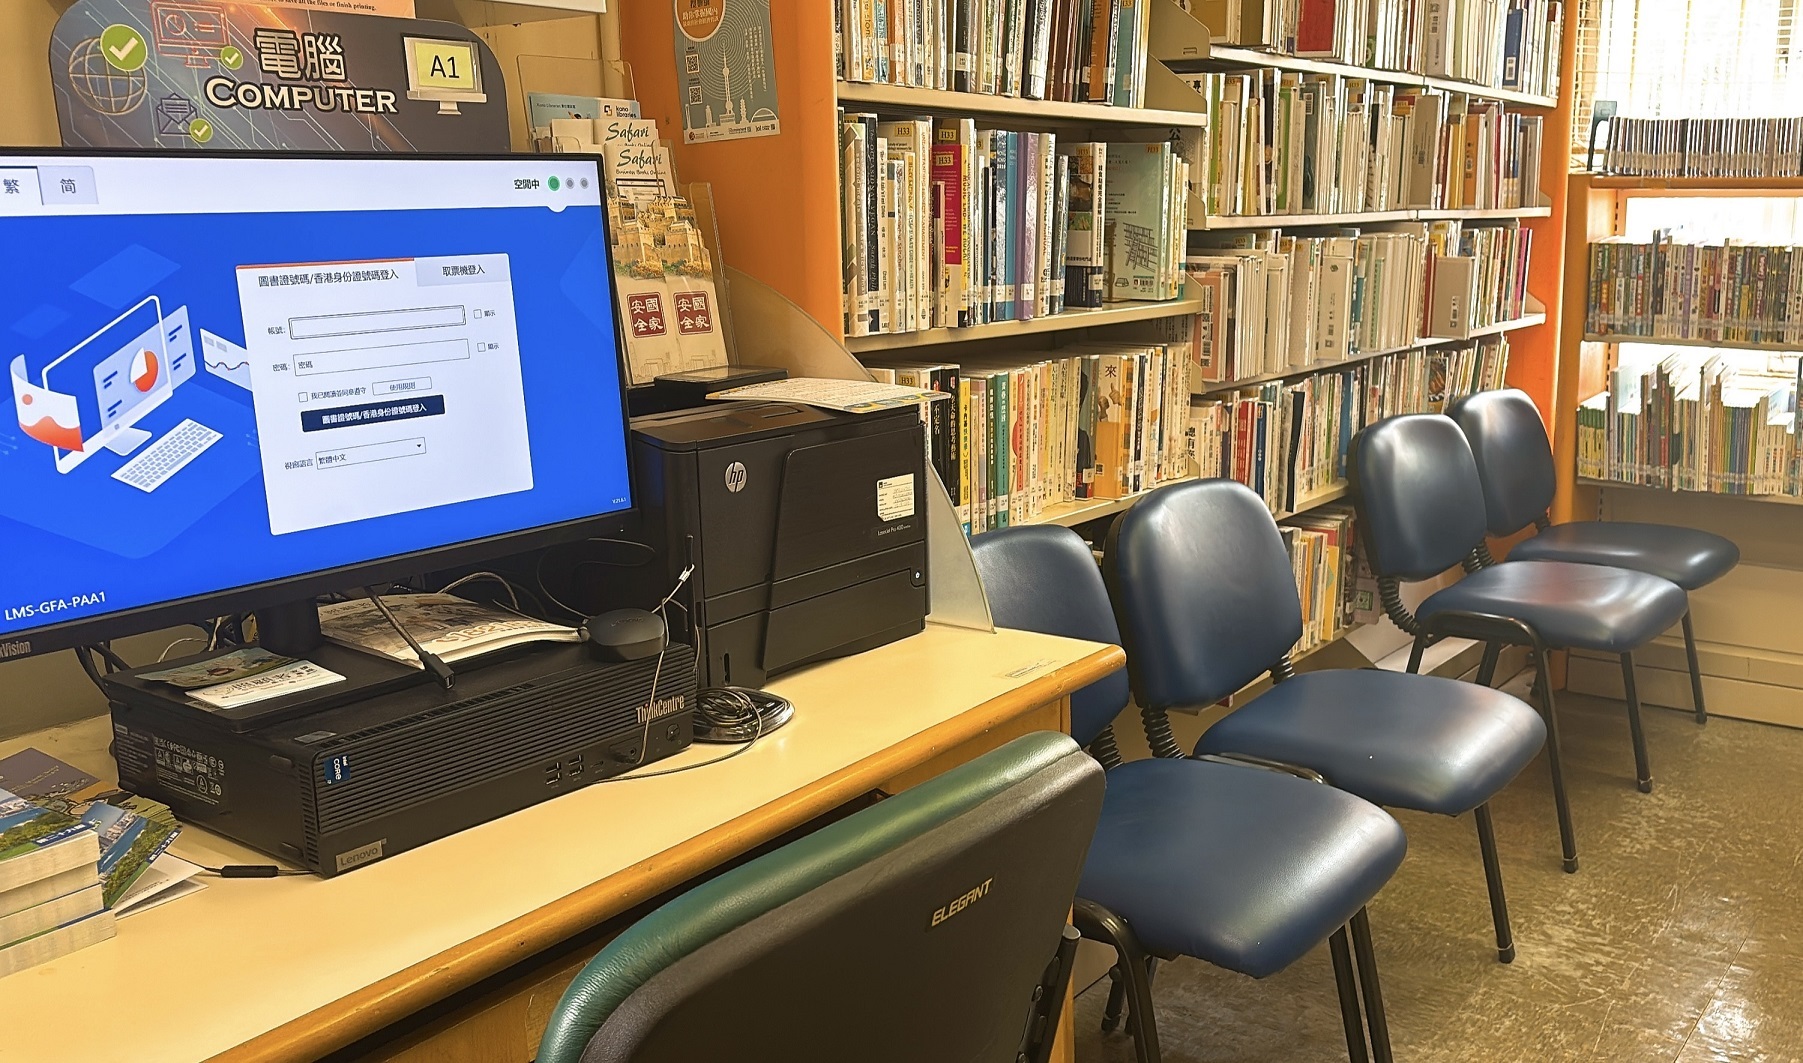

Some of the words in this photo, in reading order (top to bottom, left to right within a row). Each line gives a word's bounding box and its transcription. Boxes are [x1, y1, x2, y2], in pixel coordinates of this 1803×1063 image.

[254, 28, 346, 82] 電腦
[430, 55, 460, 79] A1
[206, 77, 398, 114] COMPUTER
[605, 122, 649, 142] Safari
[617, 149, 662, 168] Safari
[2, 178, 20, 195] 繁
[60, 178, 76, 195] 简
[258, 269, 399, 287] 圖書證號碼/香港身份證號碼登入
[1105, 365, 1117, 378] 來
[4, 591, 106, 620] LMS-GFA-PAA1
[635, 694, 685, 725] ThinkCentre
[341, 847, 378, 866] Lenovo
[931, 878, 993, 927] ELEGANT
